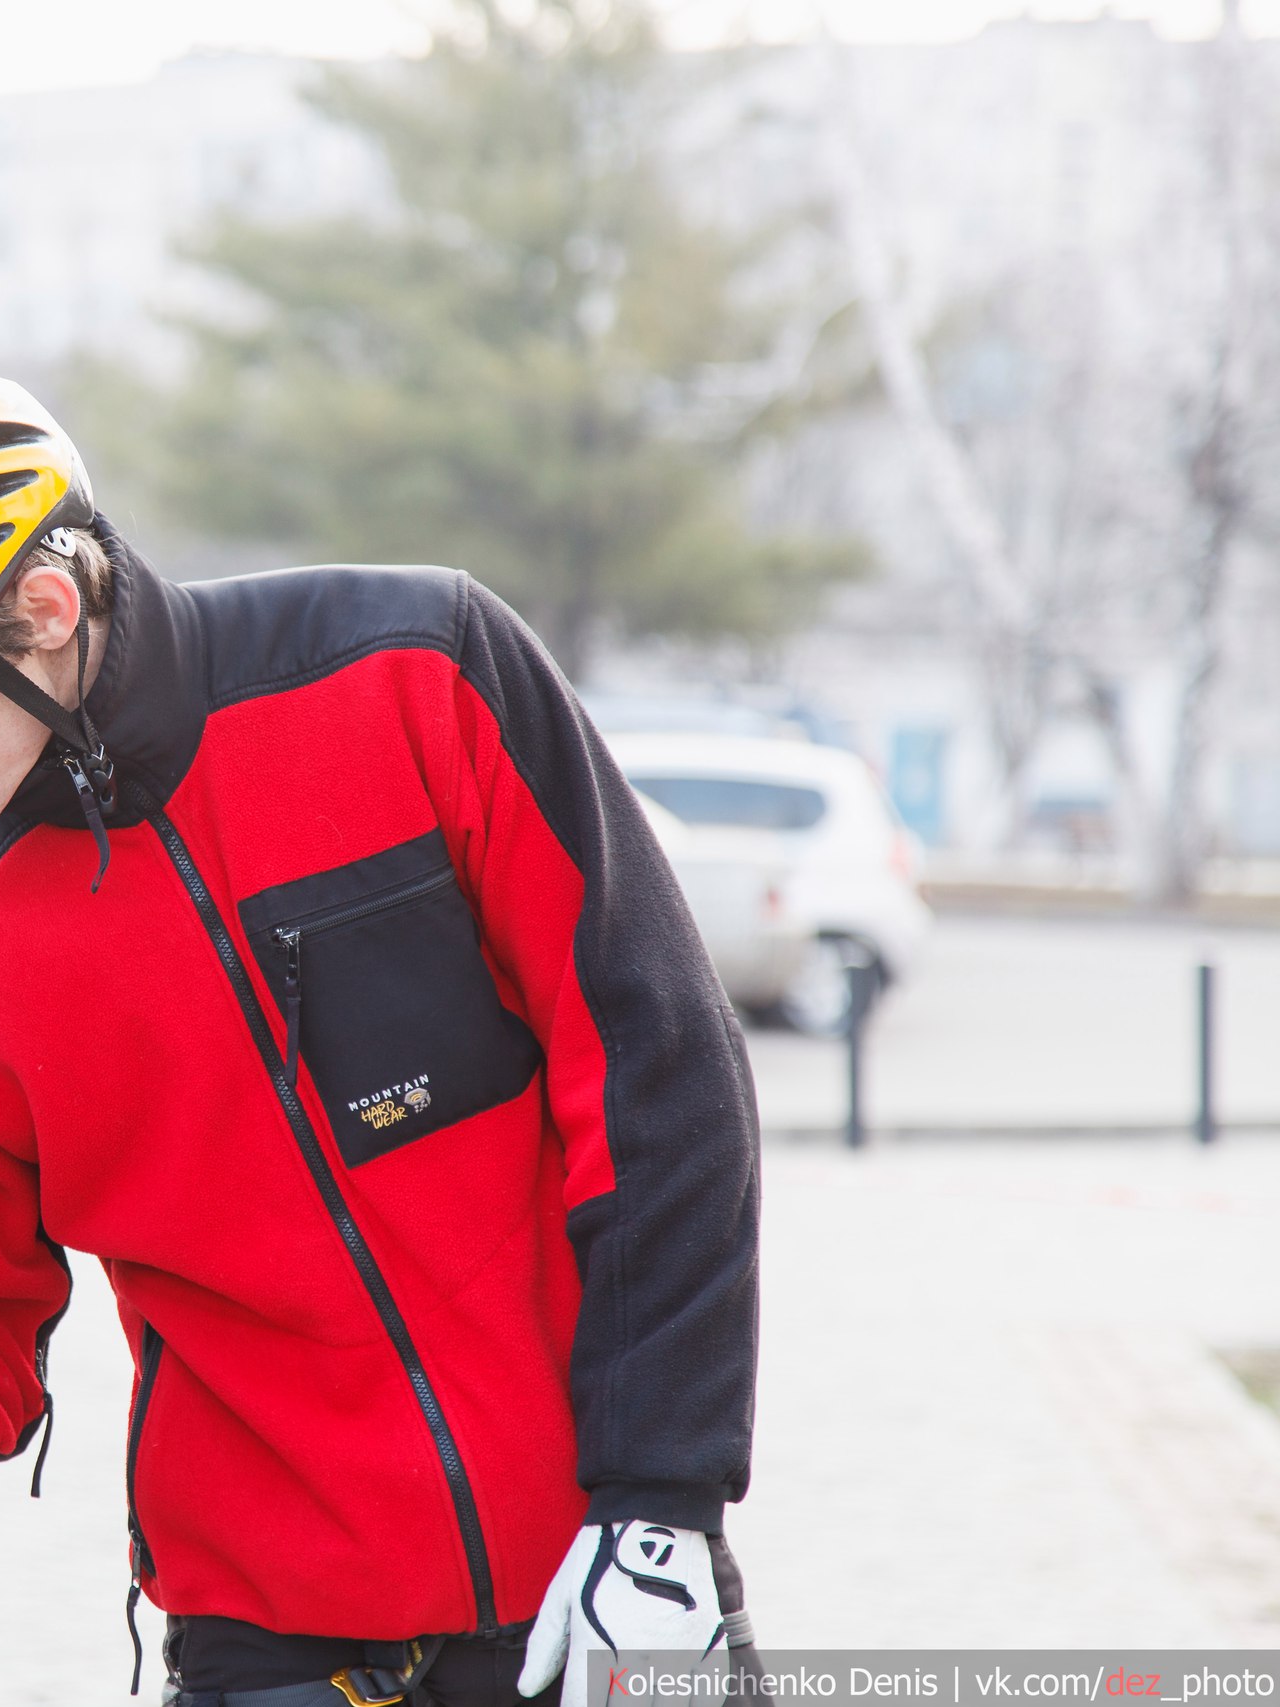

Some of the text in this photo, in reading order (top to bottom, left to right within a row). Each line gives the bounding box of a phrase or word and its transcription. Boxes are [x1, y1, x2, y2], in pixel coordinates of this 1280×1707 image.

[347, 1073, 430, 1112] MOUNTAIN
[361, 1100, 395, 1122] HARD
[371, 1106, 408, 1129] WEAR
